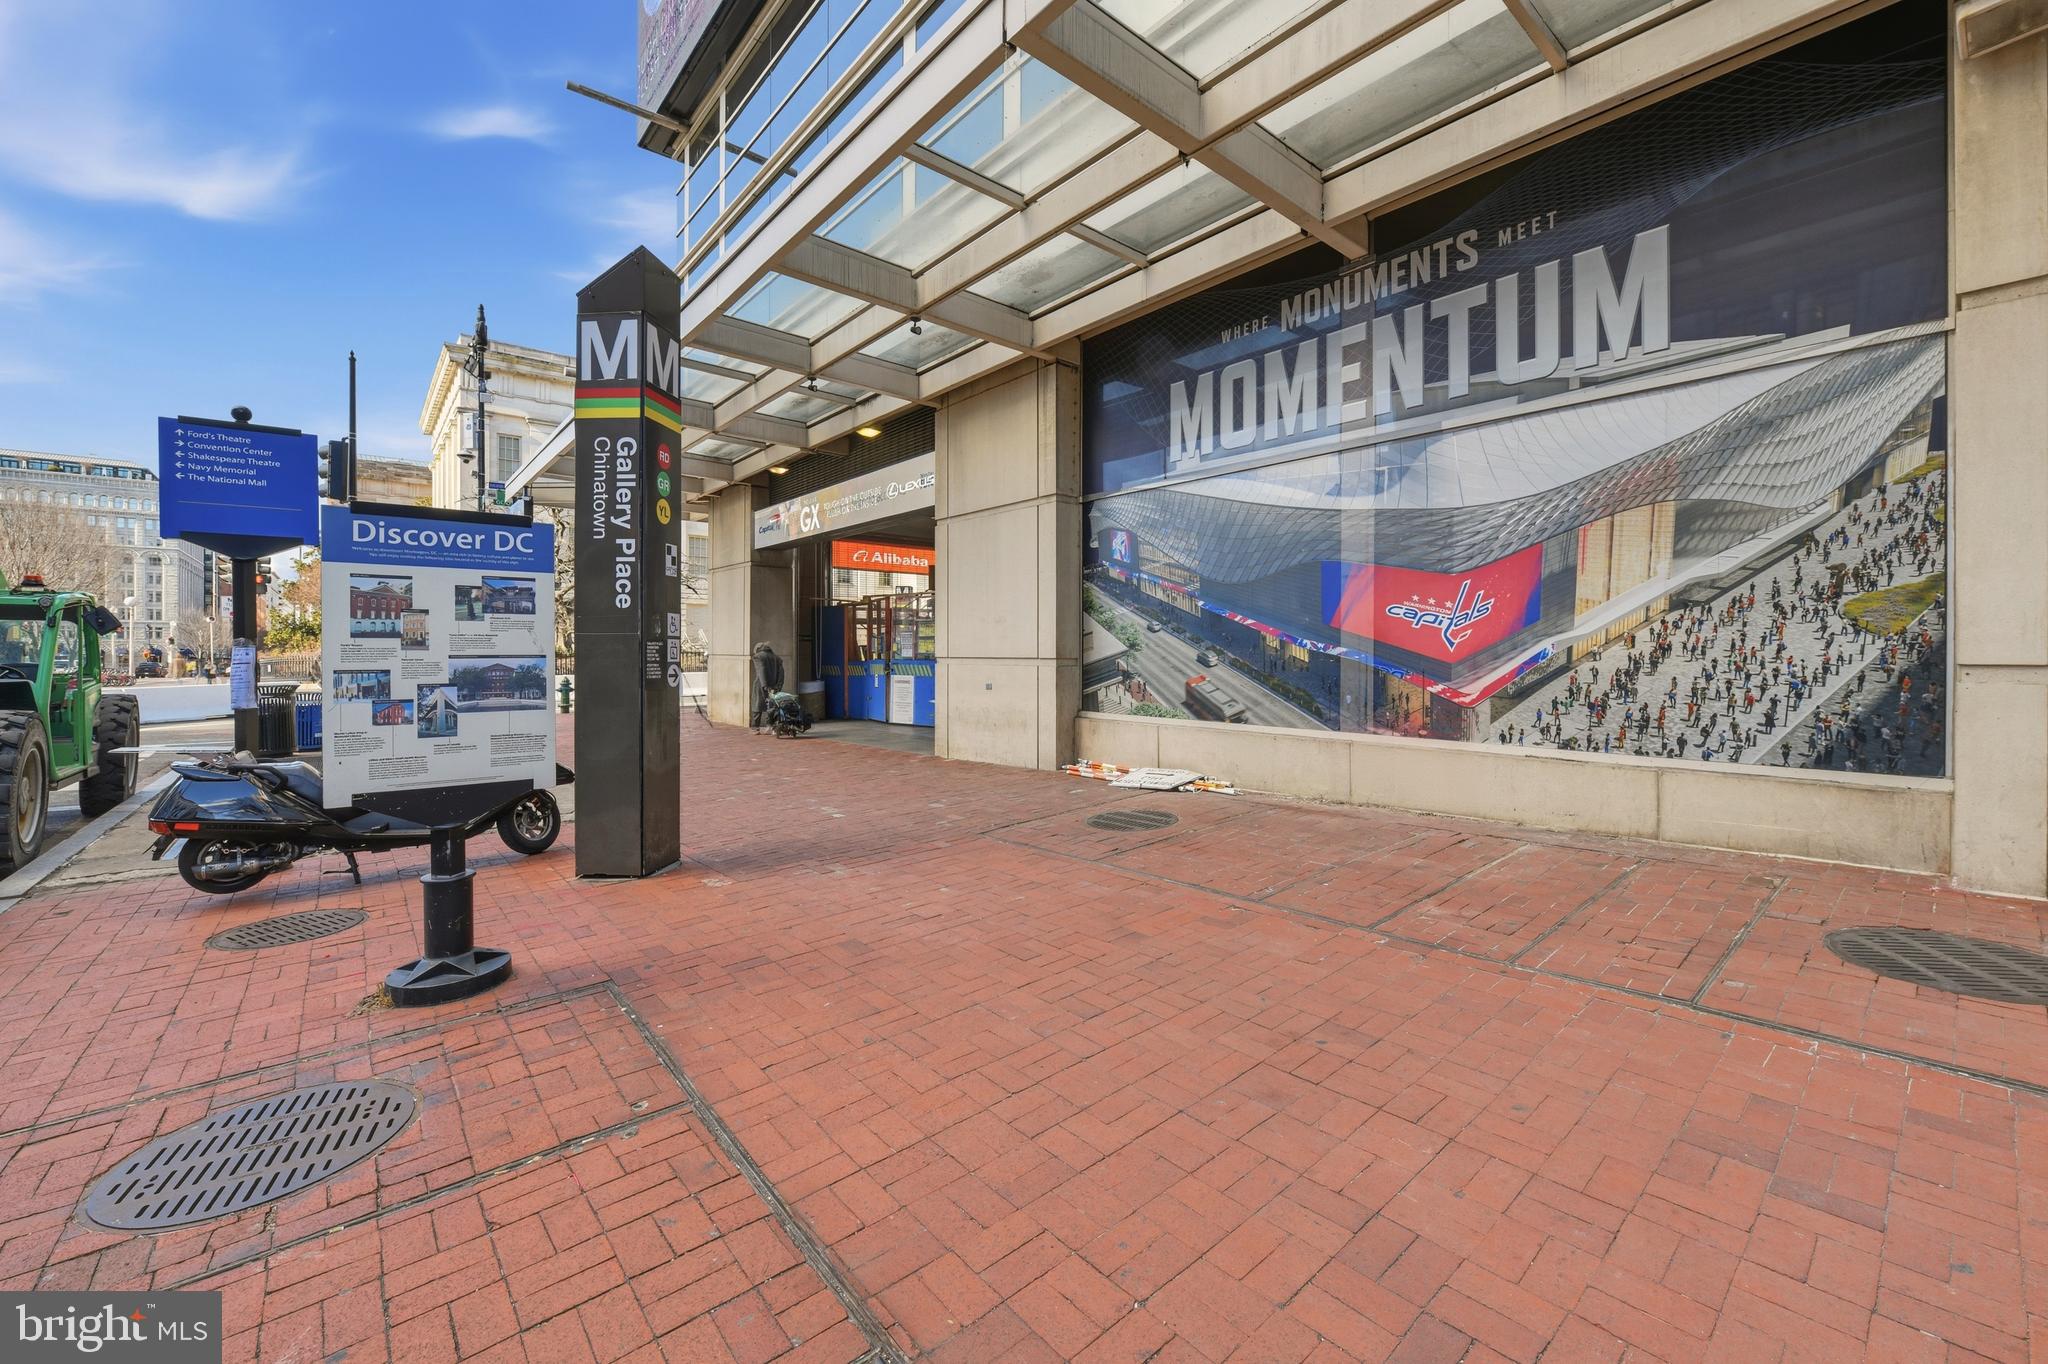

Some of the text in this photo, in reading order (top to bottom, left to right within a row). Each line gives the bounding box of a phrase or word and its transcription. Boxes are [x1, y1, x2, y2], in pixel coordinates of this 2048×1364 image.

[1221, 210, 1558, 344] WHERE MONUMENTS MEET
[581, 319, 638, 381] M
[1169, 223, 1671, 462] MOMENTUM
[646, 321, 680, 399] M
[187, 430, 251, 444] Ford's Theatre
[187, 441, 272, 457] Convention Center
[659, 450, 670, 463] RD
[187, 451, 281, 468] Shakespeare Theatre
[188, 462, 256, 476] Navy Memorial
[188, 473, 267, 487] The National Mall
[593, 436, 611, 539] Chinatown
[657, 478, 670, 491] GR
[899, 474, 935, 493] LEXUS
[659, 505, 669, 518] YL
[800, 502, 820, 532] GX
[610, 436, 638, 609] Gallery Place
[352, 519, 533, 553] Discover DC
[871, 551, 928, 567] Alibaba
[1386, 579, 1495, 653] capitals
